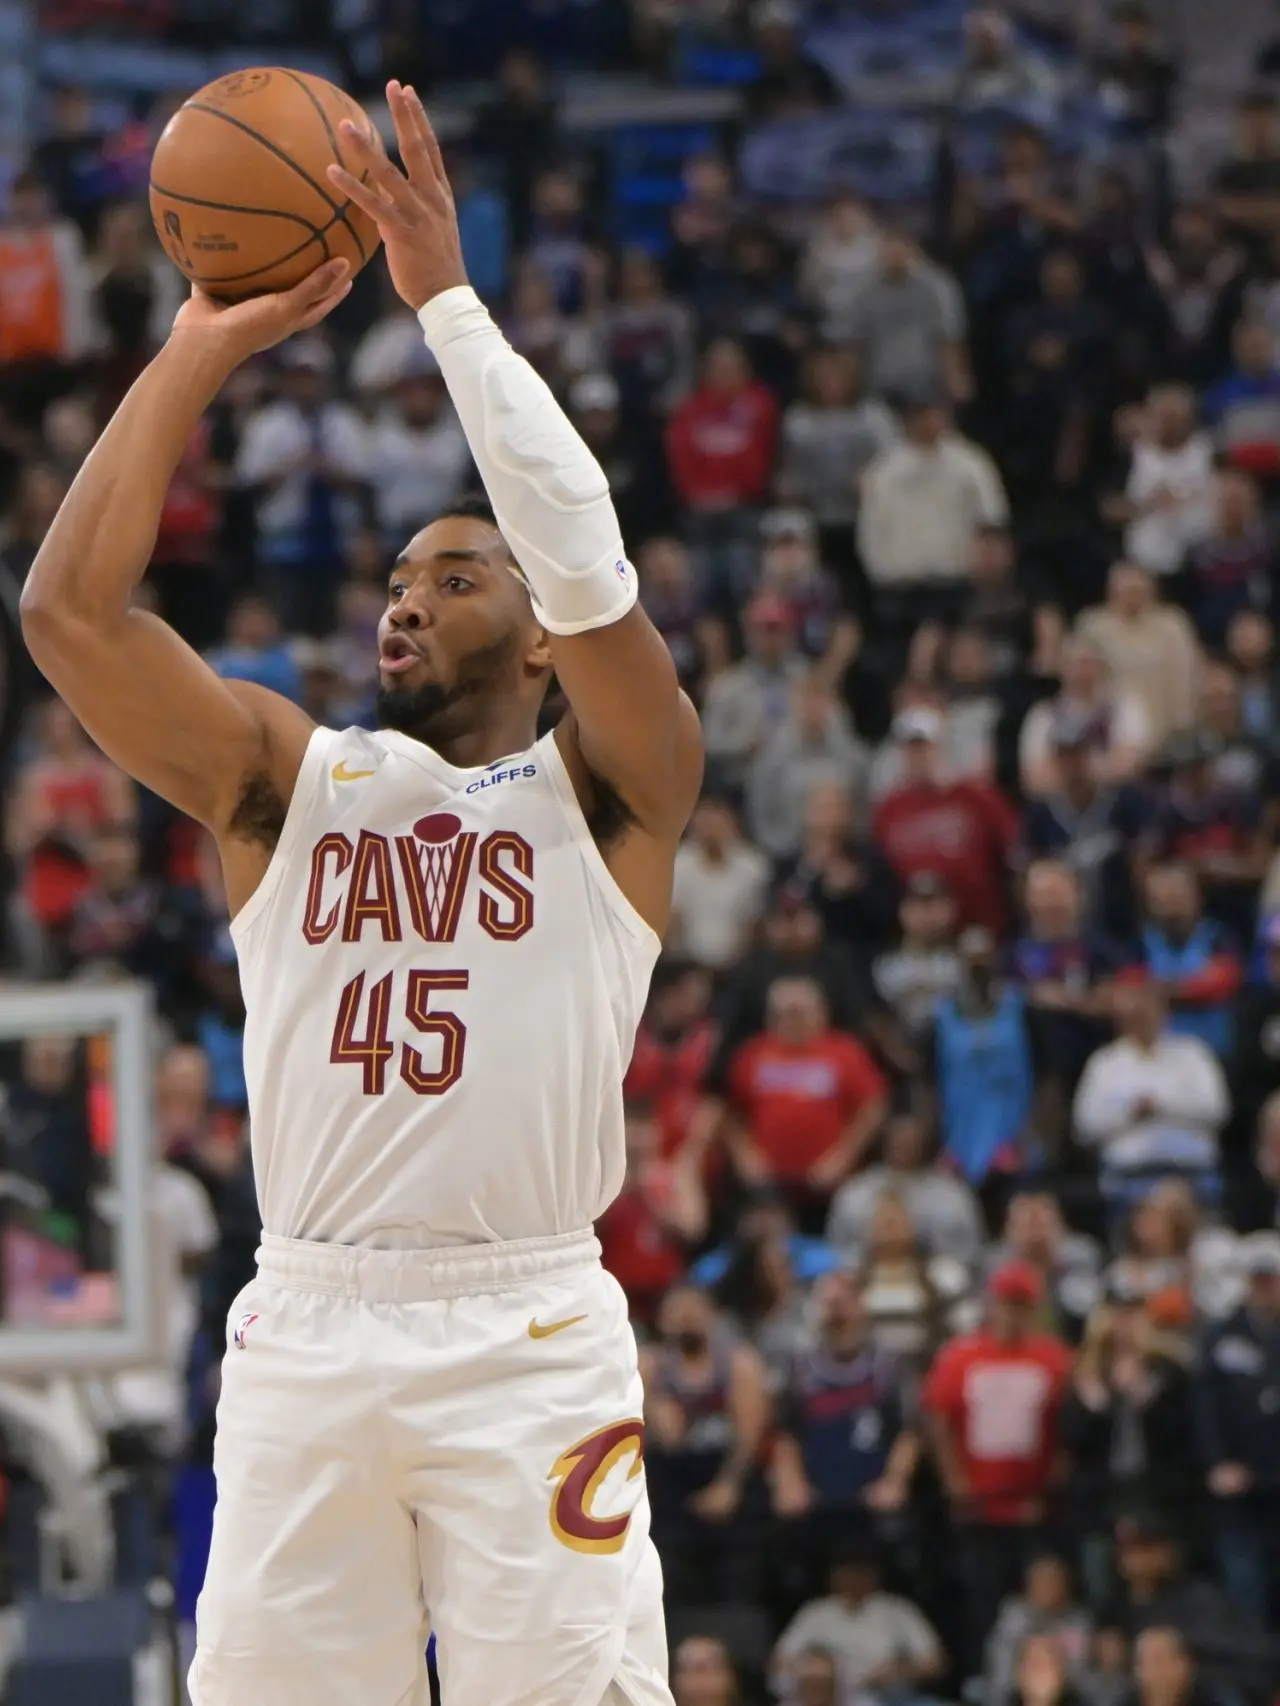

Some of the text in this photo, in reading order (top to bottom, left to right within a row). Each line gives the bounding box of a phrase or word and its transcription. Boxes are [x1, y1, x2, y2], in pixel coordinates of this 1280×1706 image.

[465, 764, 537, 795] CLIFFS
[301, 828, 535, 946] CAVS
[329, 968, 469, 1095] 45
